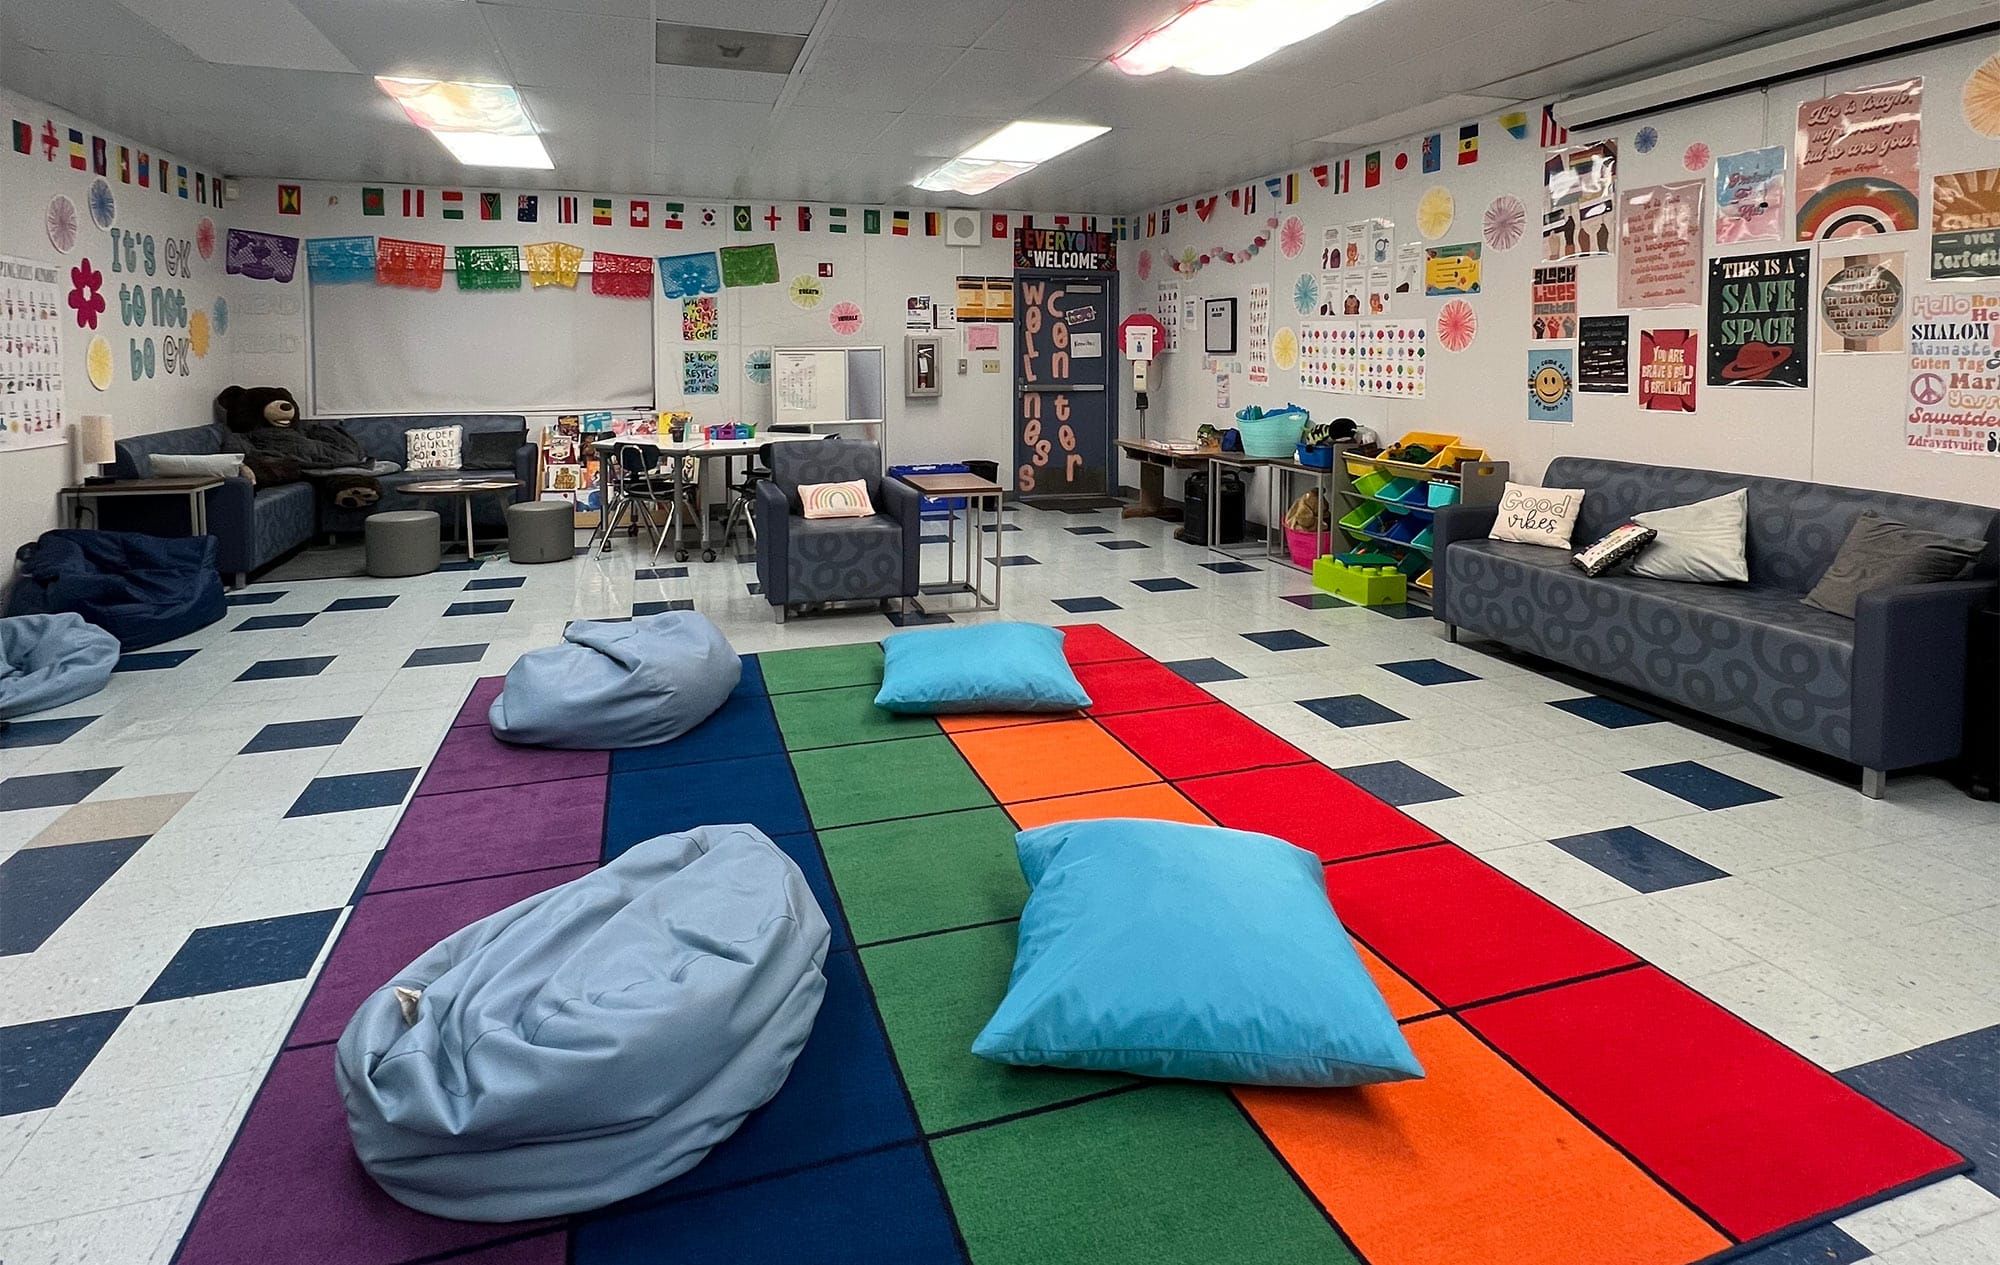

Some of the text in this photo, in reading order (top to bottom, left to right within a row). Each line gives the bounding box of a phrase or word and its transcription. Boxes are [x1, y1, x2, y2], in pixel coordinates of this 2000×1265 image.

[1848, 143, 1879, 158] are
[1025, 230, 1107, 254] EVERYONE
[1033, 250, 1098, 270] WELCOME
[1722, 256, 1795, 279] THIS IS A
[151, 286, 188, 329] not
[1722, 279, 1796, 314] SAFE
[1911, 294, 2000, 321] Hello Bo
[1721, 316, 1795, 345] SPACE
[1911, 322, 1990, 340] SHALOM
[1667, 348, 1685, 363] ARE
[1911, 341, 1992, 356] Namaste
[1911, 356, 1951, 370] Guten
[1958, 356, 1985, 373] Tag
[1948, 389, 2000, 410] Yass
[1908, 406, 2000, 428] Sawatde
[1502, 489, 1572, 519] Good
[1508, 508, 1558, 534] vibes
